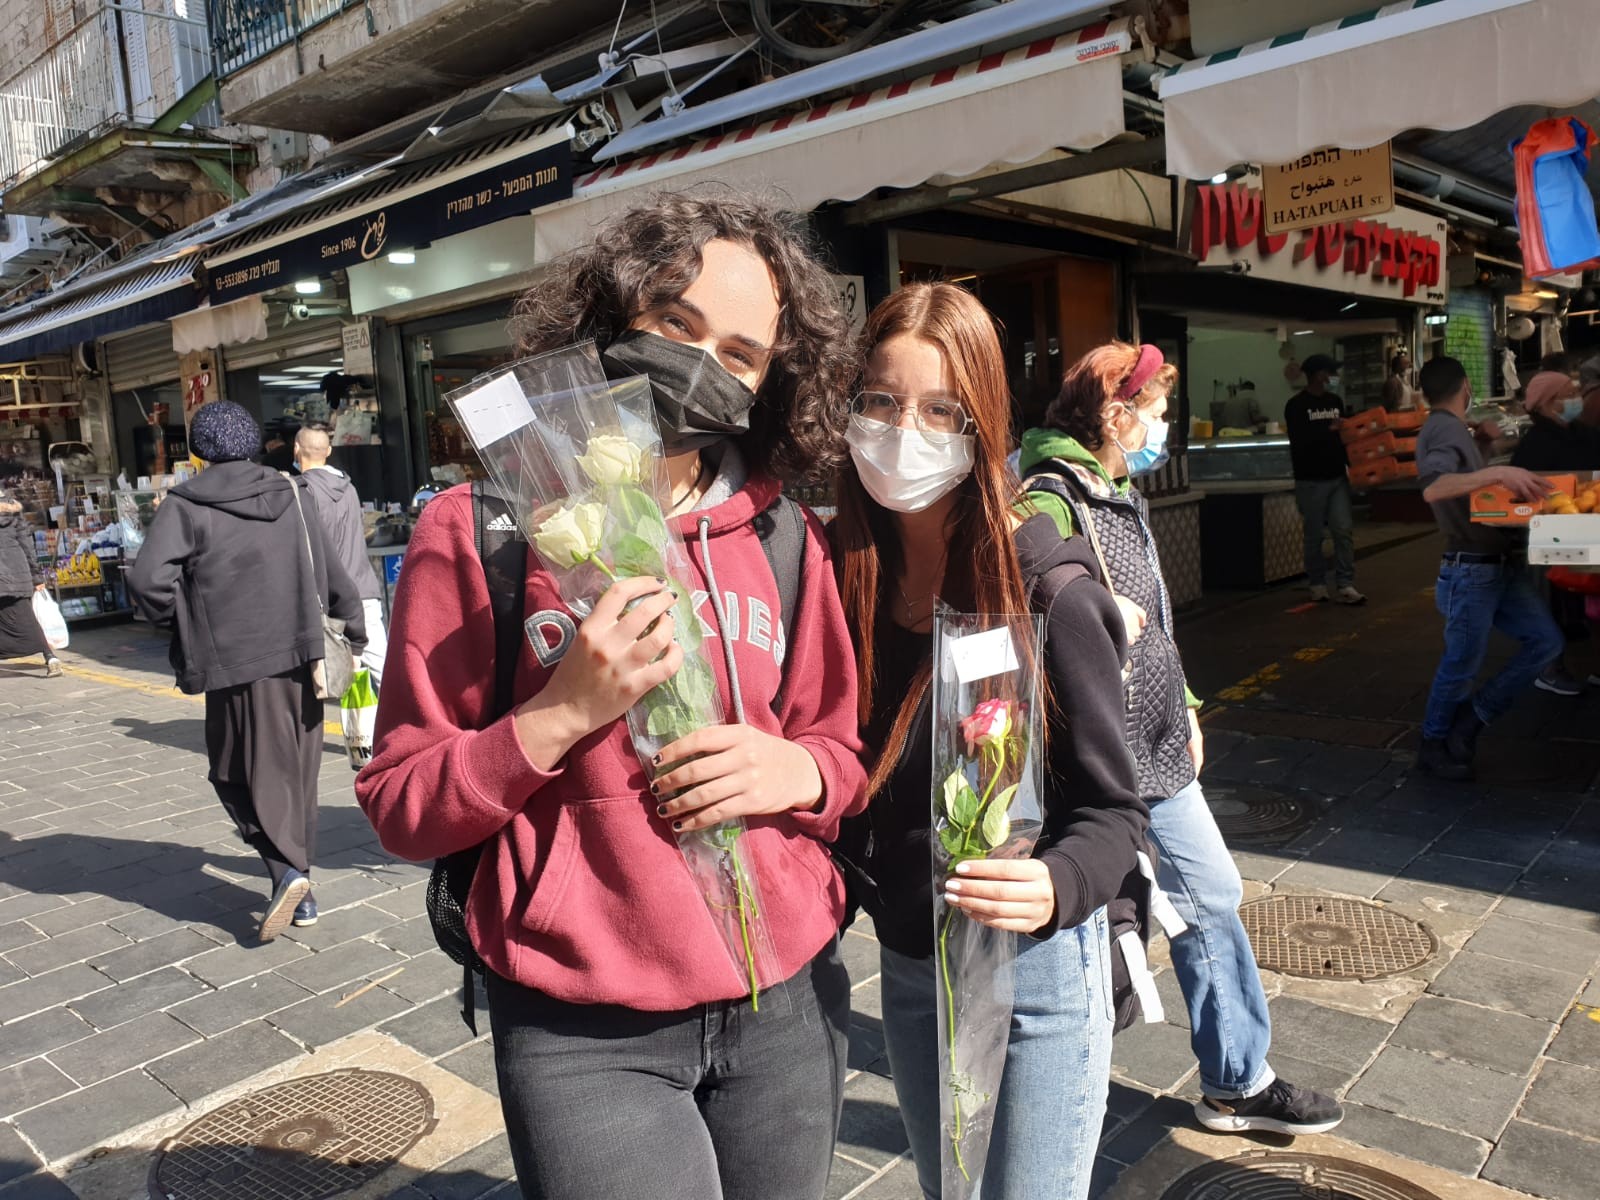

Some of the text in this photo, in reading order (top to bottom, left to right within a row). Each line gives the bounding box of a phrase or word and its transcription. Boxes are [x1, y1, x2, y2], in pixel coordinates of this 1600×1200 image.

[502, 174, 532, 198] המפעל
[536, 166, 558, 187] חנות
[447, 196, 473, 220] מהדרין
[476, 189, 492, 207] כשר
[1273, 194, 1363, 224] HA-TAPUAH
[321, 237, 357, 258] Since 1906
[1344, 219, 1441, 298] הקצביה
[524, 589, 786, 668] DKIES
